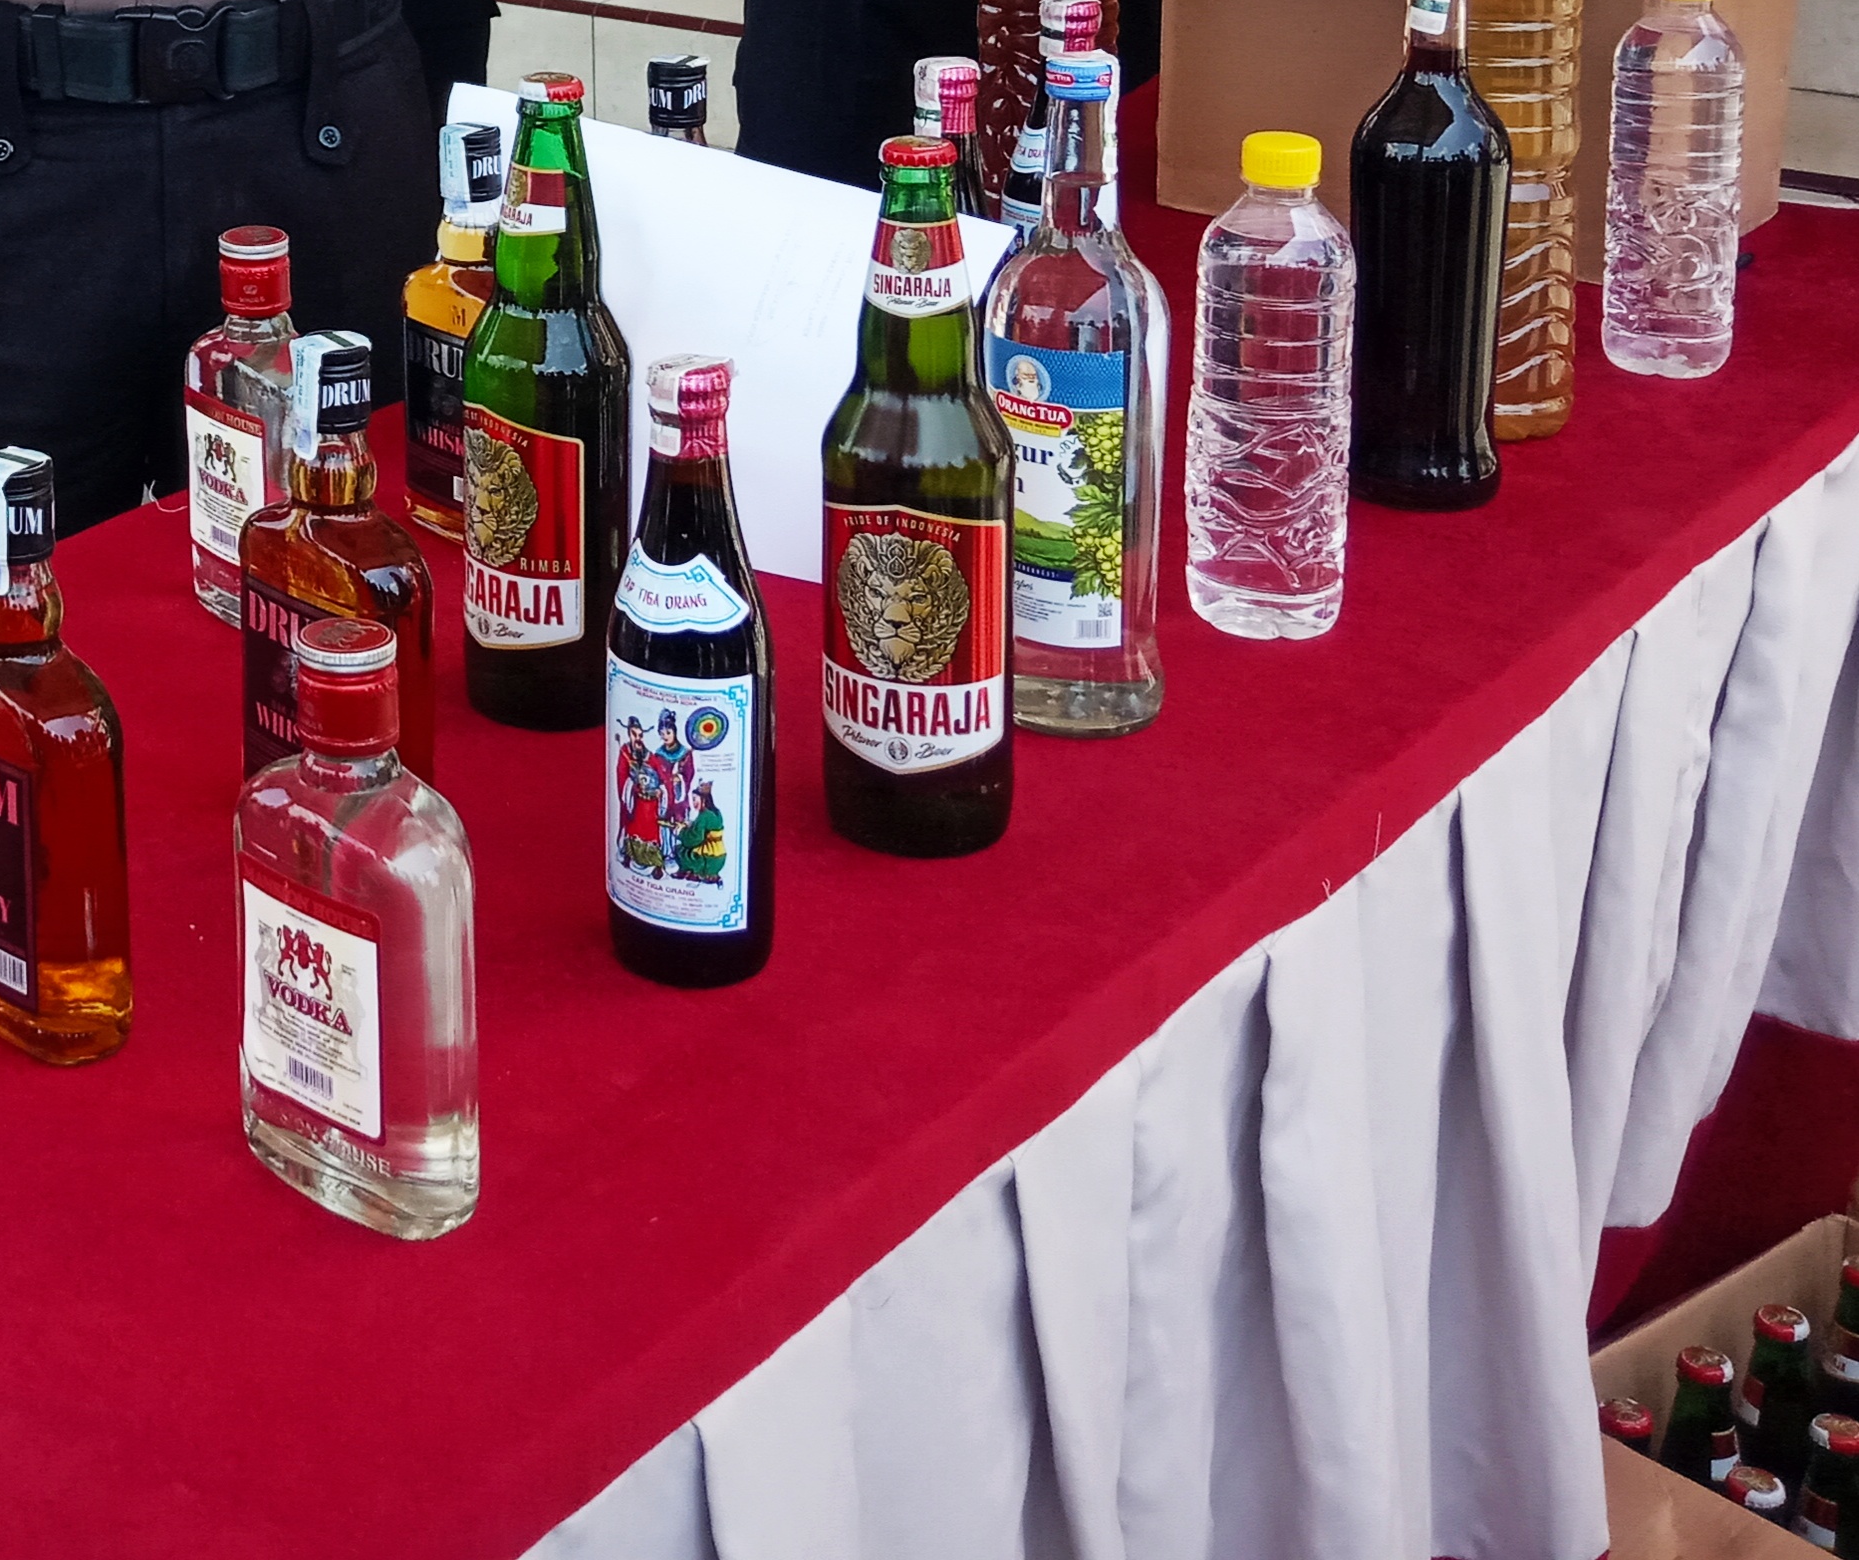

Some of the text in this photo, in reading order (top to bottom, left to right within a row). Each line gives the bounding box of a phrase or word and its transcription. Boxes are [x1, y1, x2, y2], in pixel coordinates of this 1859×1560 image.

[873, 273, 952, 298] SINGARAJA
[997, 393, 1068, 424] ORANG TUA
[225, 412, 263, 436] HOUSE
[197, 466, 249, 506] VODKA
[844, 515, 962, 543] PRIDE OF INDONESIA
[520, 557, 572, 574] RIMBA
[664, 593, 708, 610] ORANG
[824, 665, 992, 737] SINGARAJA
[841, 723, 954, 760] Pilsner Beer
[263, 969, 353, 1037] VODKA
